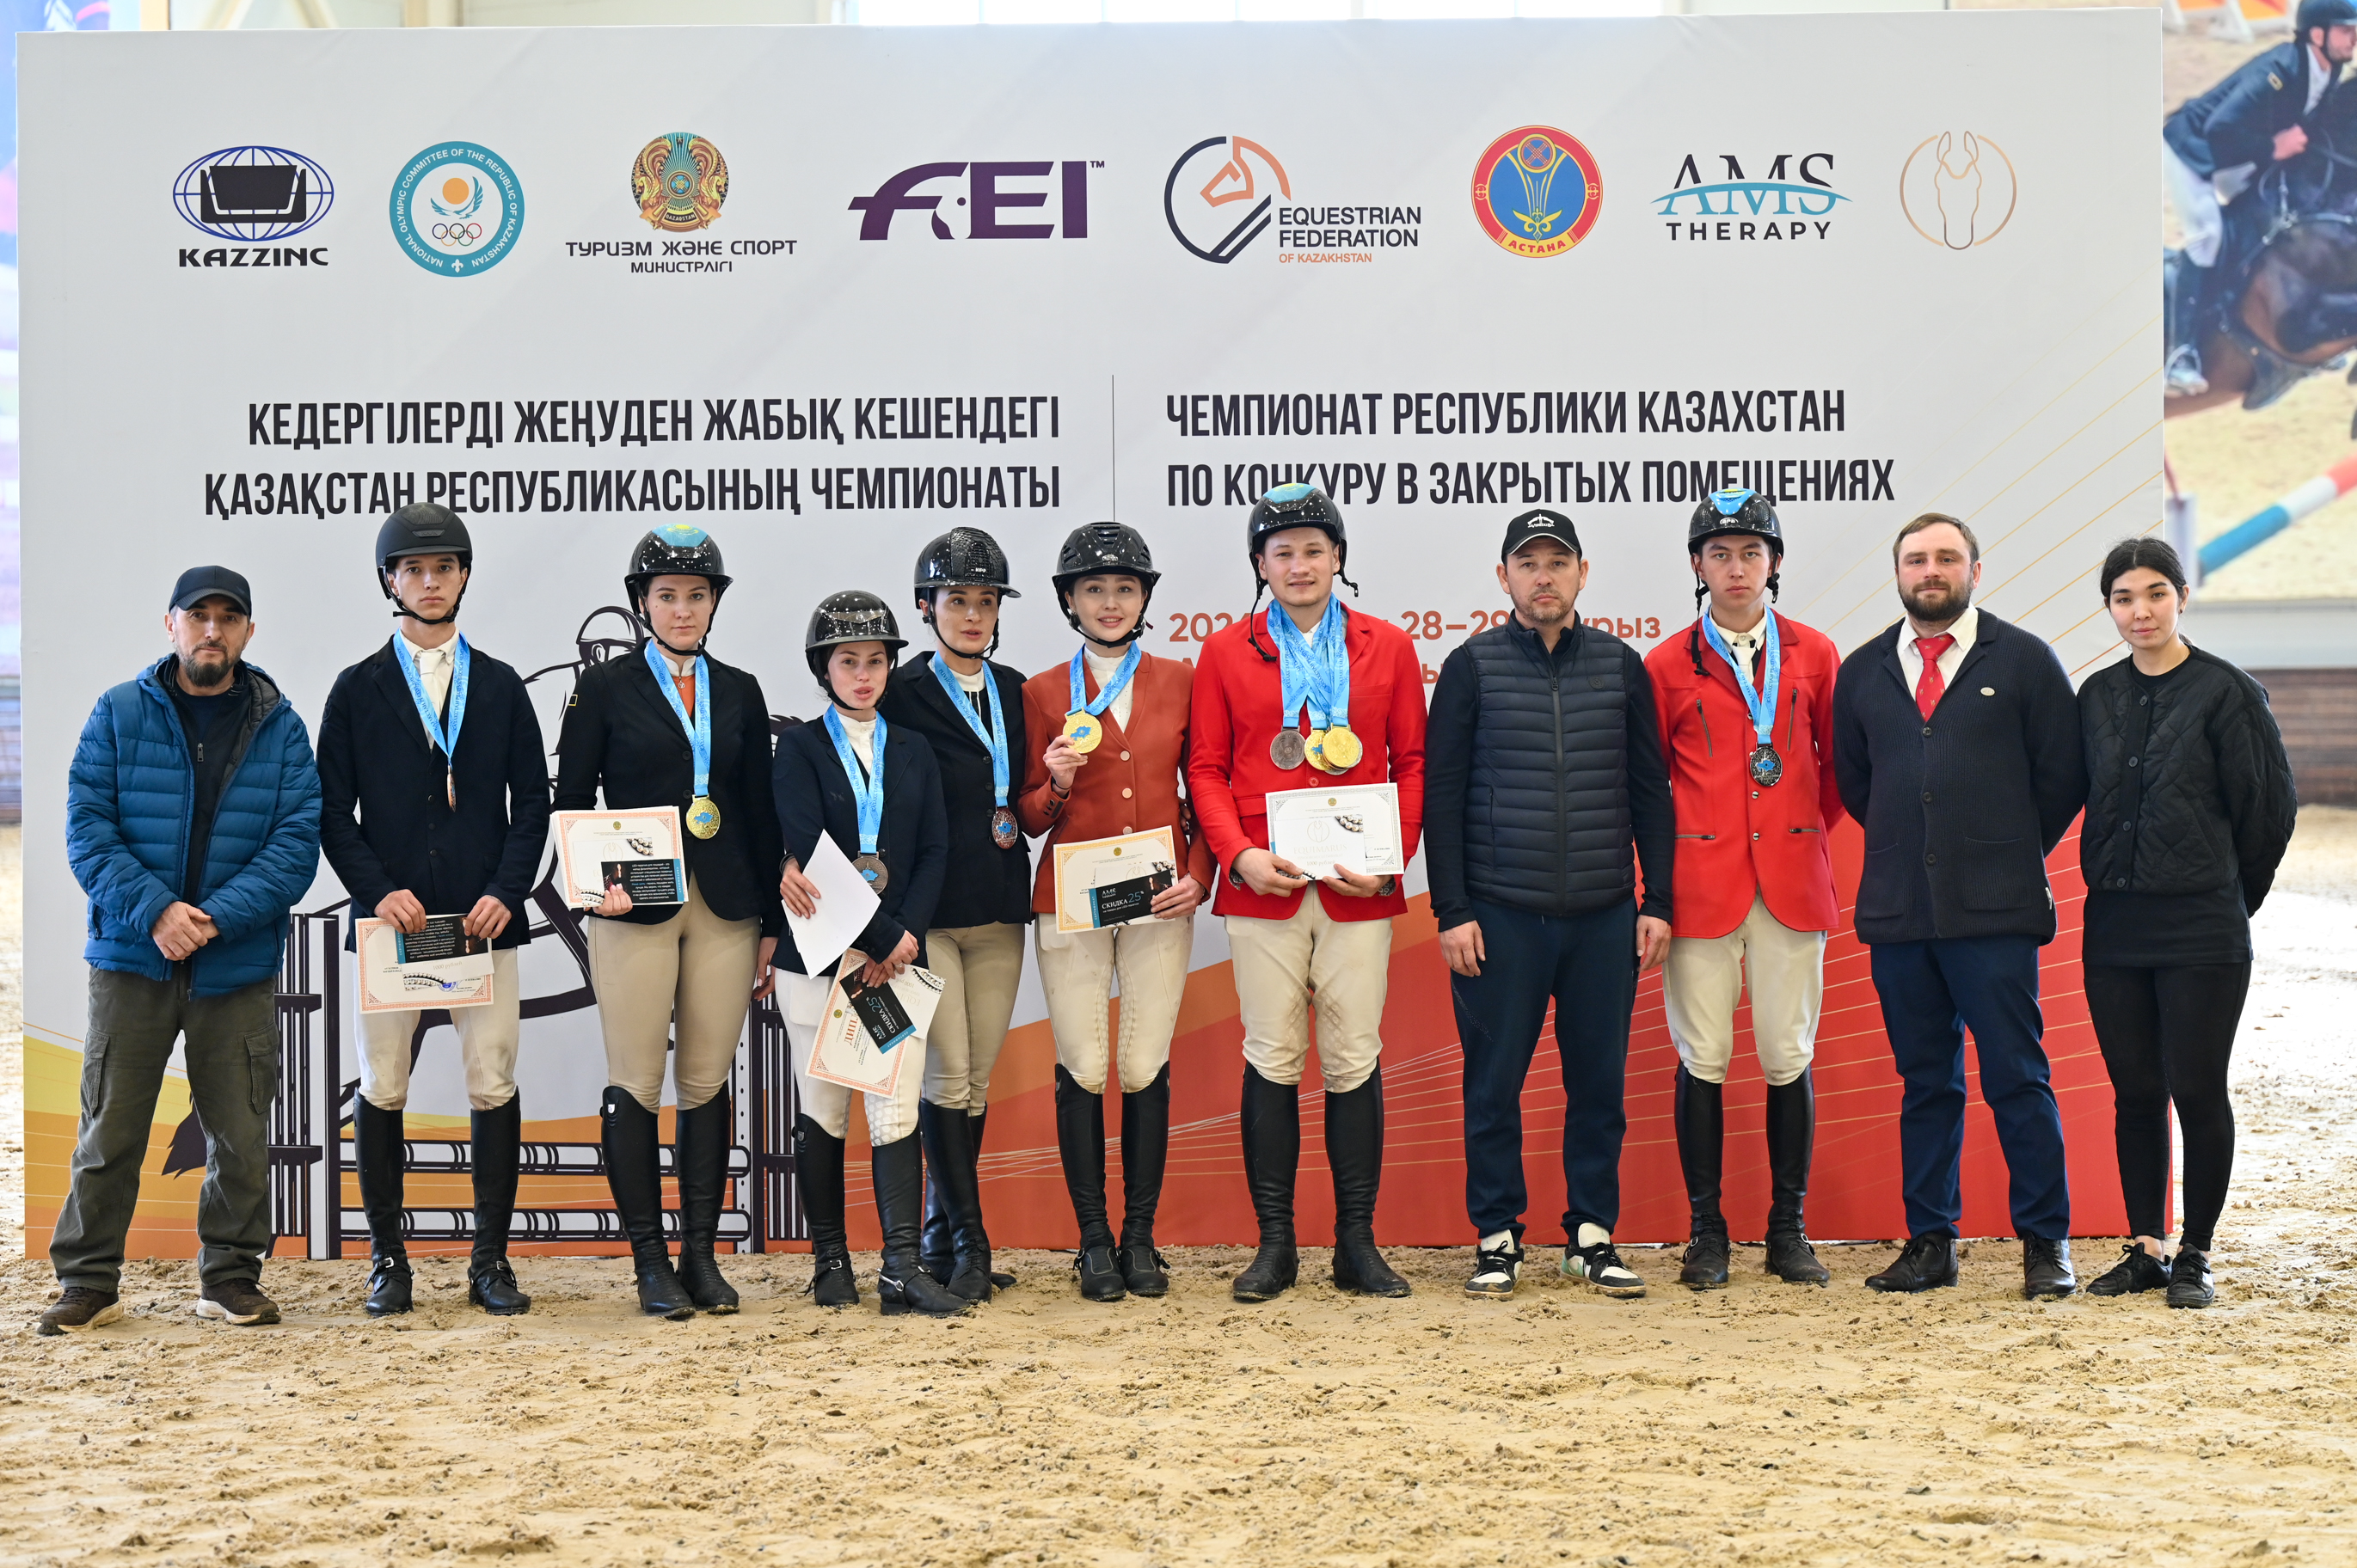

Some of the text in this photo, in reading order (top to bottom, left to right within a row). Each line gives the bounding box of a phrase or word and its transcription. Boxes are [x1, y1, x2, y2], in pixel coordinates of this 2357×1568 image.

[1656, 152, 1837, 217] AMS
[396, 148, 518, 268] NATIONAL OLYMPIC COMMITTEE OF THE REPUBLIC OF KAZAKHSTAN
[1279, 205, 1421, 227] EQUESTRIAN
[1279, 228, 1419, 248] FEDERATION
[1666, 221, 1832, 242] THERAPY
[565, 239, 798, 257] ТУРИЗМ ЖӘНЕ СПОРТ
[1508, 238, 1567, 254] АСТАНА
[178, 247, 329, 268] KAZZINC
[630, 260, 733, 273] МИНИСТРЛІГІ
[1279, 253, 1372, 264] OF KAZAKHSTAN
[249, 395, 1059, 450] КЕДЕРГІЛЕРДІ ЖЕҢУДЕН ЖАБЫҚ КЕШЕНДЕГІ
[1166, 389, 1845, 437] ЧЕМПИОНАТ РЕСПУБЛИКИ КАЗАХСТАН
[205, 466, 1059, 521] ҚАЗАҚСТАН РЕСПУБЛИКАСЫНЫҢ ЧЕМПИОНАТЫ
[1168, 464, 1213, 506] ПО
[1396, 462, 1419, 505] В
[1429, 461, 1632, 504] ЗАКРЫТЫХ
[1642, 458, 1895, 508] ПОМЕЩЕНИЯХ
[1102, 898, 1128, 910] СКИДКА
[879, 1008, 896, 1034] СКИДКА
